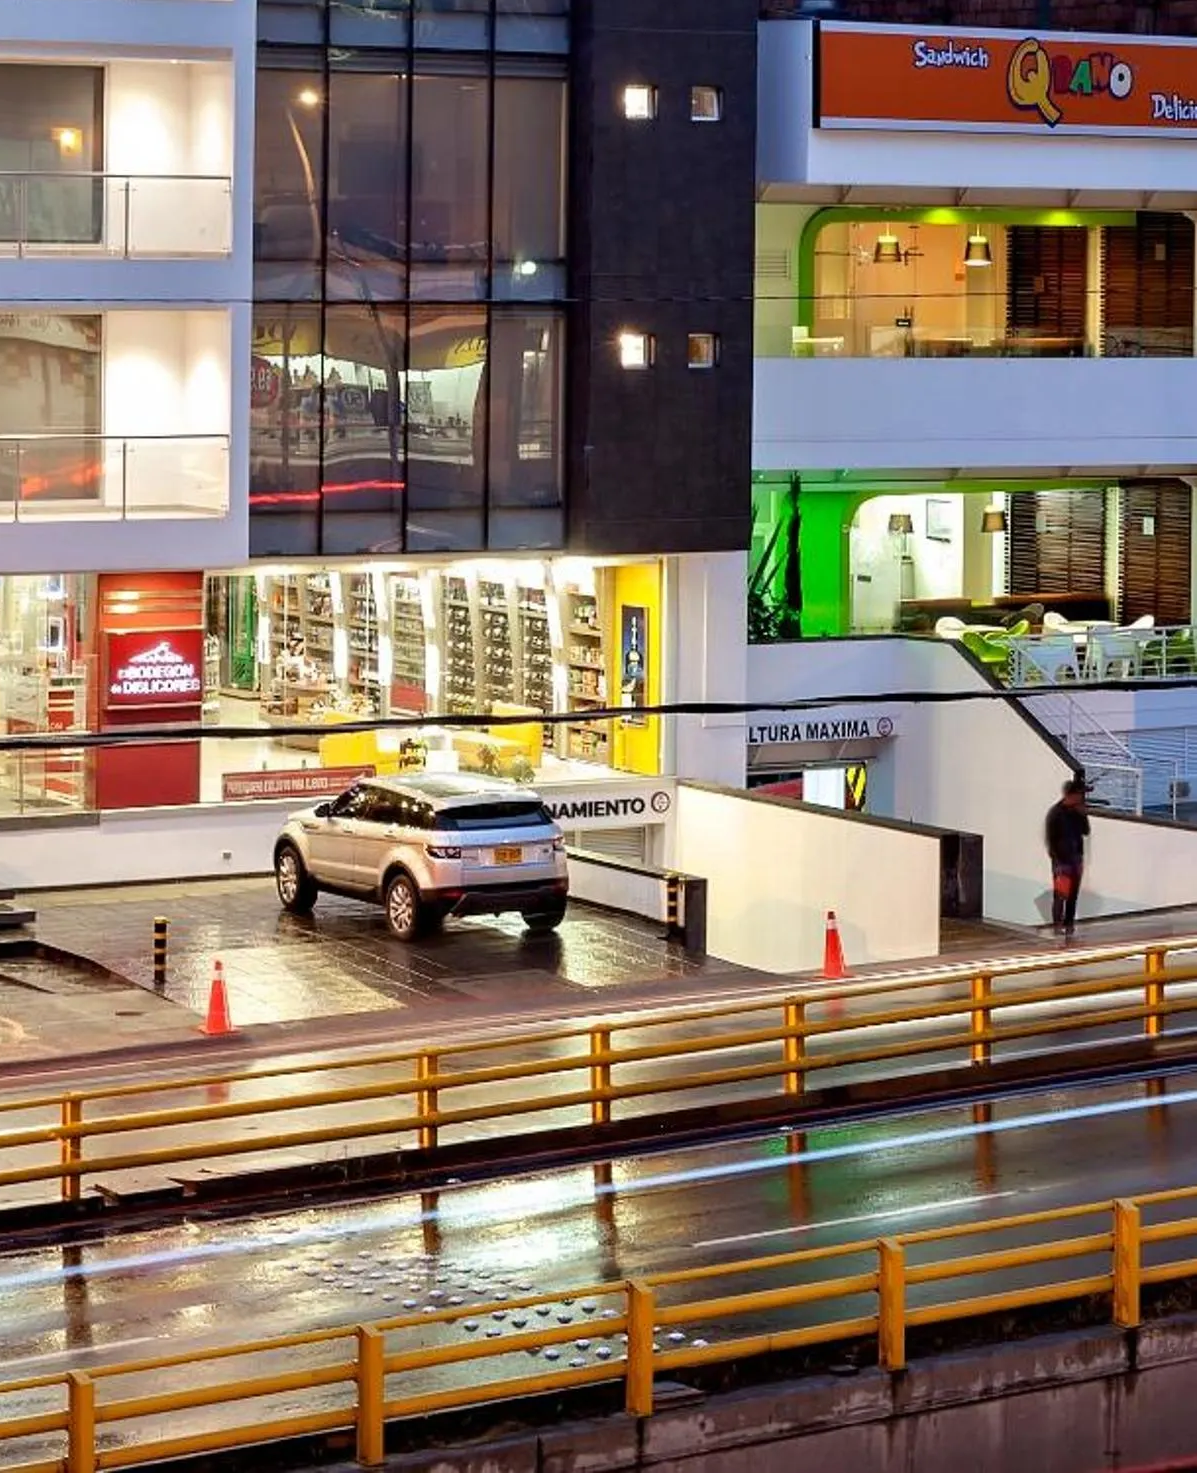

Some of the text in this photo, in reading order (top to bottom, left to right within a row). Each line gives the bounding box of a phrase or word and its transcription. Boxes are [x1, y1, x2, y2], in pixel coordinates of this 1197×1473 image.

[913, 40, 989, 69] Sandwich
[748, 724, 801, 743] LTURA
[805, 720, 870, 740] MAXIMA
[544, 797, 646, 819] NAMIENTO
